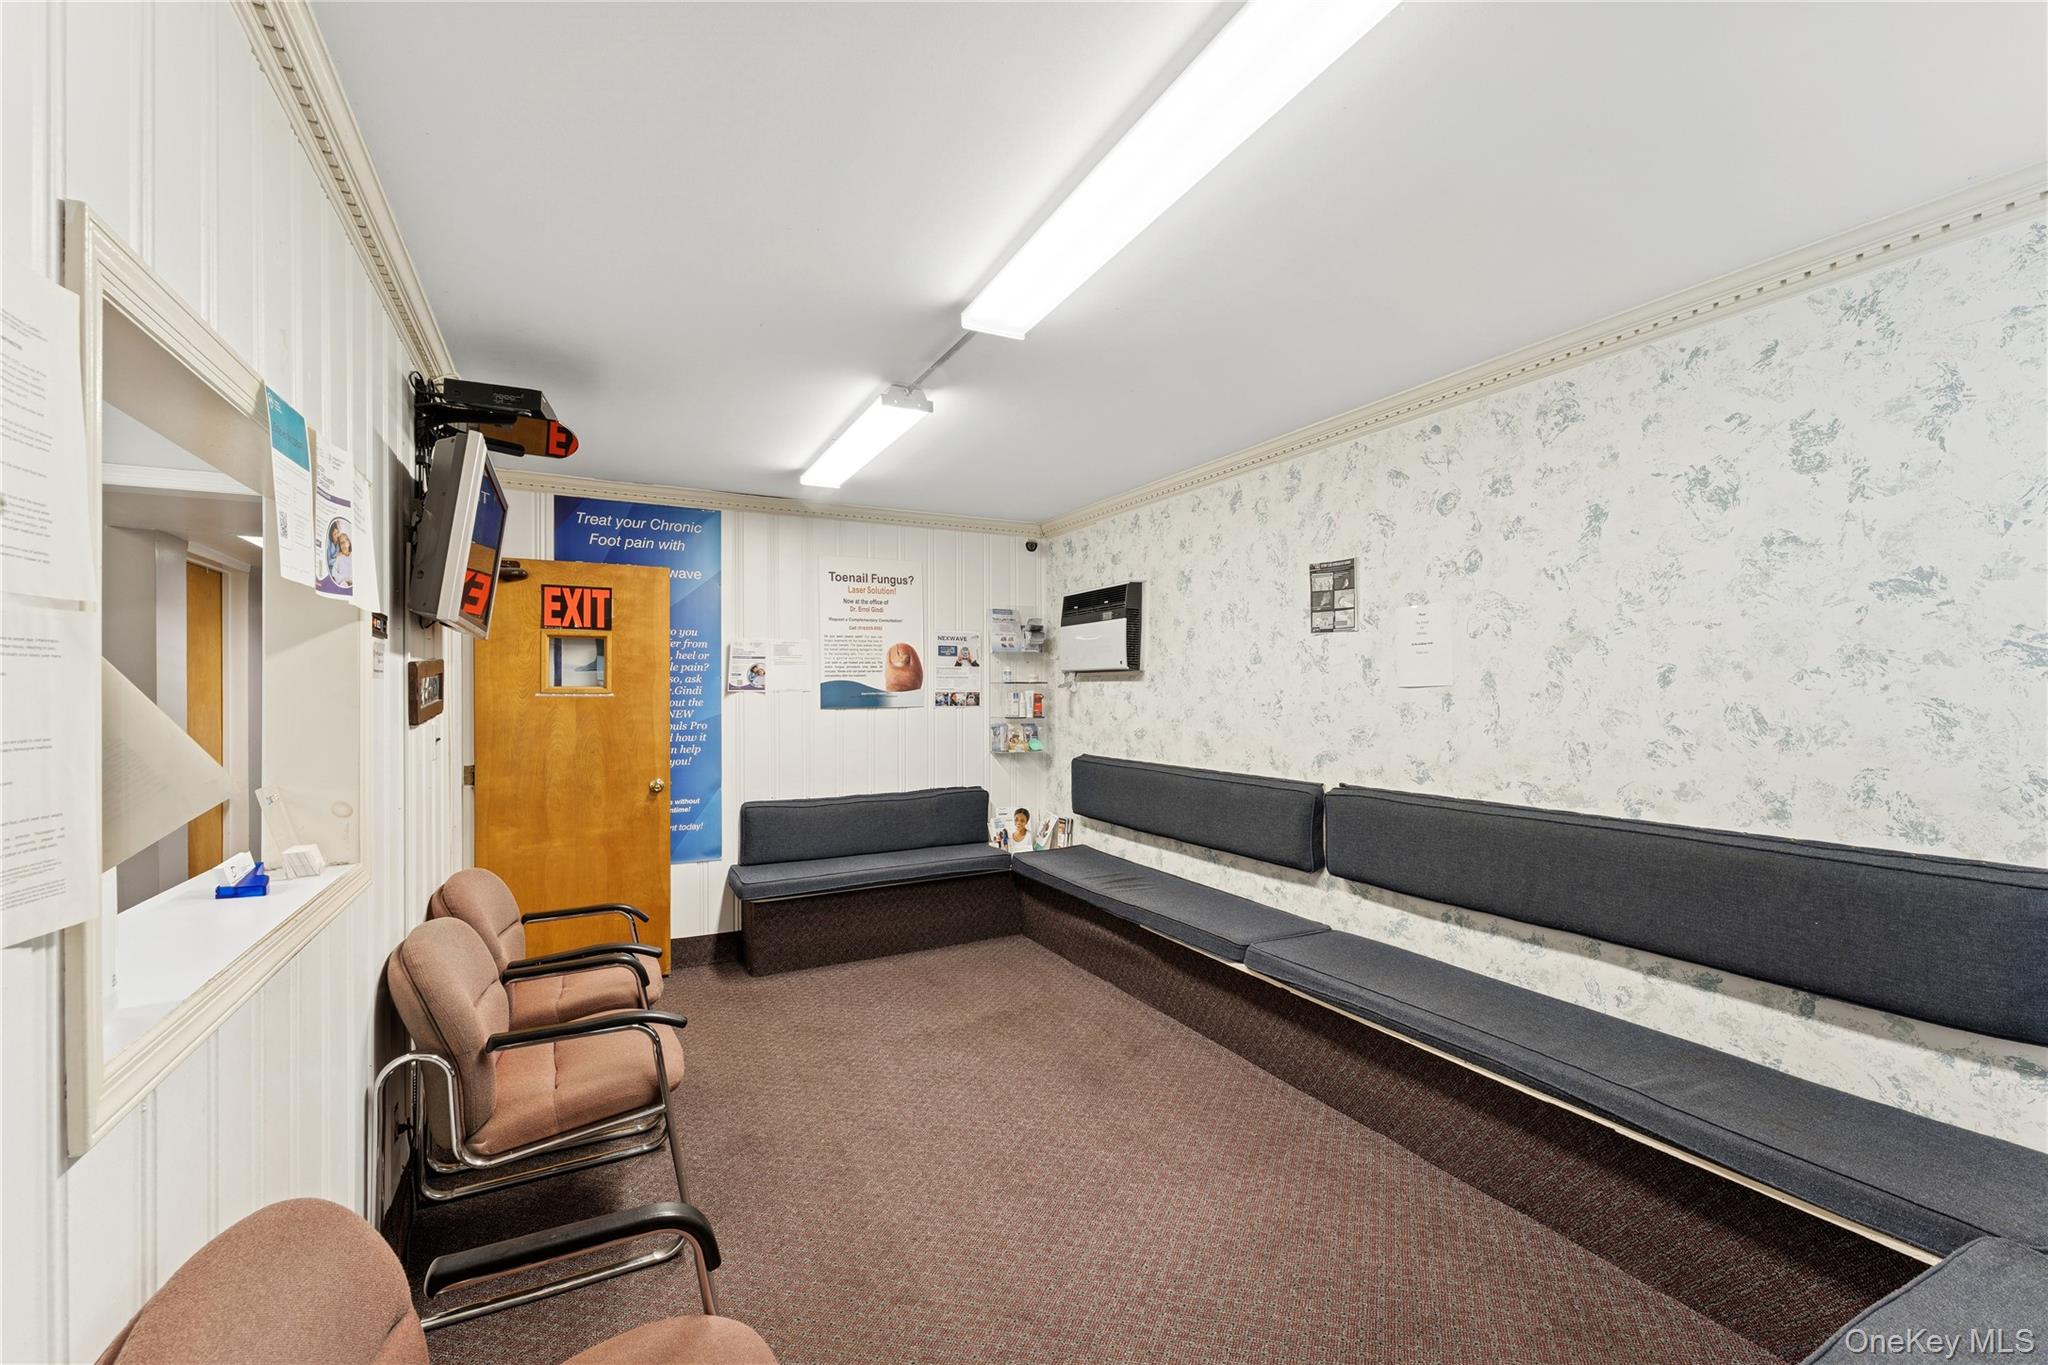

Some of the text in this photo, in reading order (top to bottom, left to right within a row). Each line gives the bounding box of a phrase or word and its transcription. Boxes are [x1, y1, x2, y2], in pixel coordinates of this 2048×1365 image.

[576, 511, 703, 534] Treat your Chronic
[589, 533, 686, 552] Foot pain with
[828, 571, 915, 587] Toenail Fungus?
[847, 585, 897, 595] Laser Solution!
[543, 586, 610, 628] EXIT
[679, 629, 698, 639] you
[682, 639, 708, 652] from
[676, 650, 696, 660] heel
[680, 663, 710, 674] pain?
[684, 674, 702, 683] ask
[688, 697, 704, 707] the
[690, 721, 708, 730] Pro
[675, 733, 697, 742] how
[699, 732, 707, 742] it
[680, 744, 701, 755] help
[679, 822, 704, 832] today!
